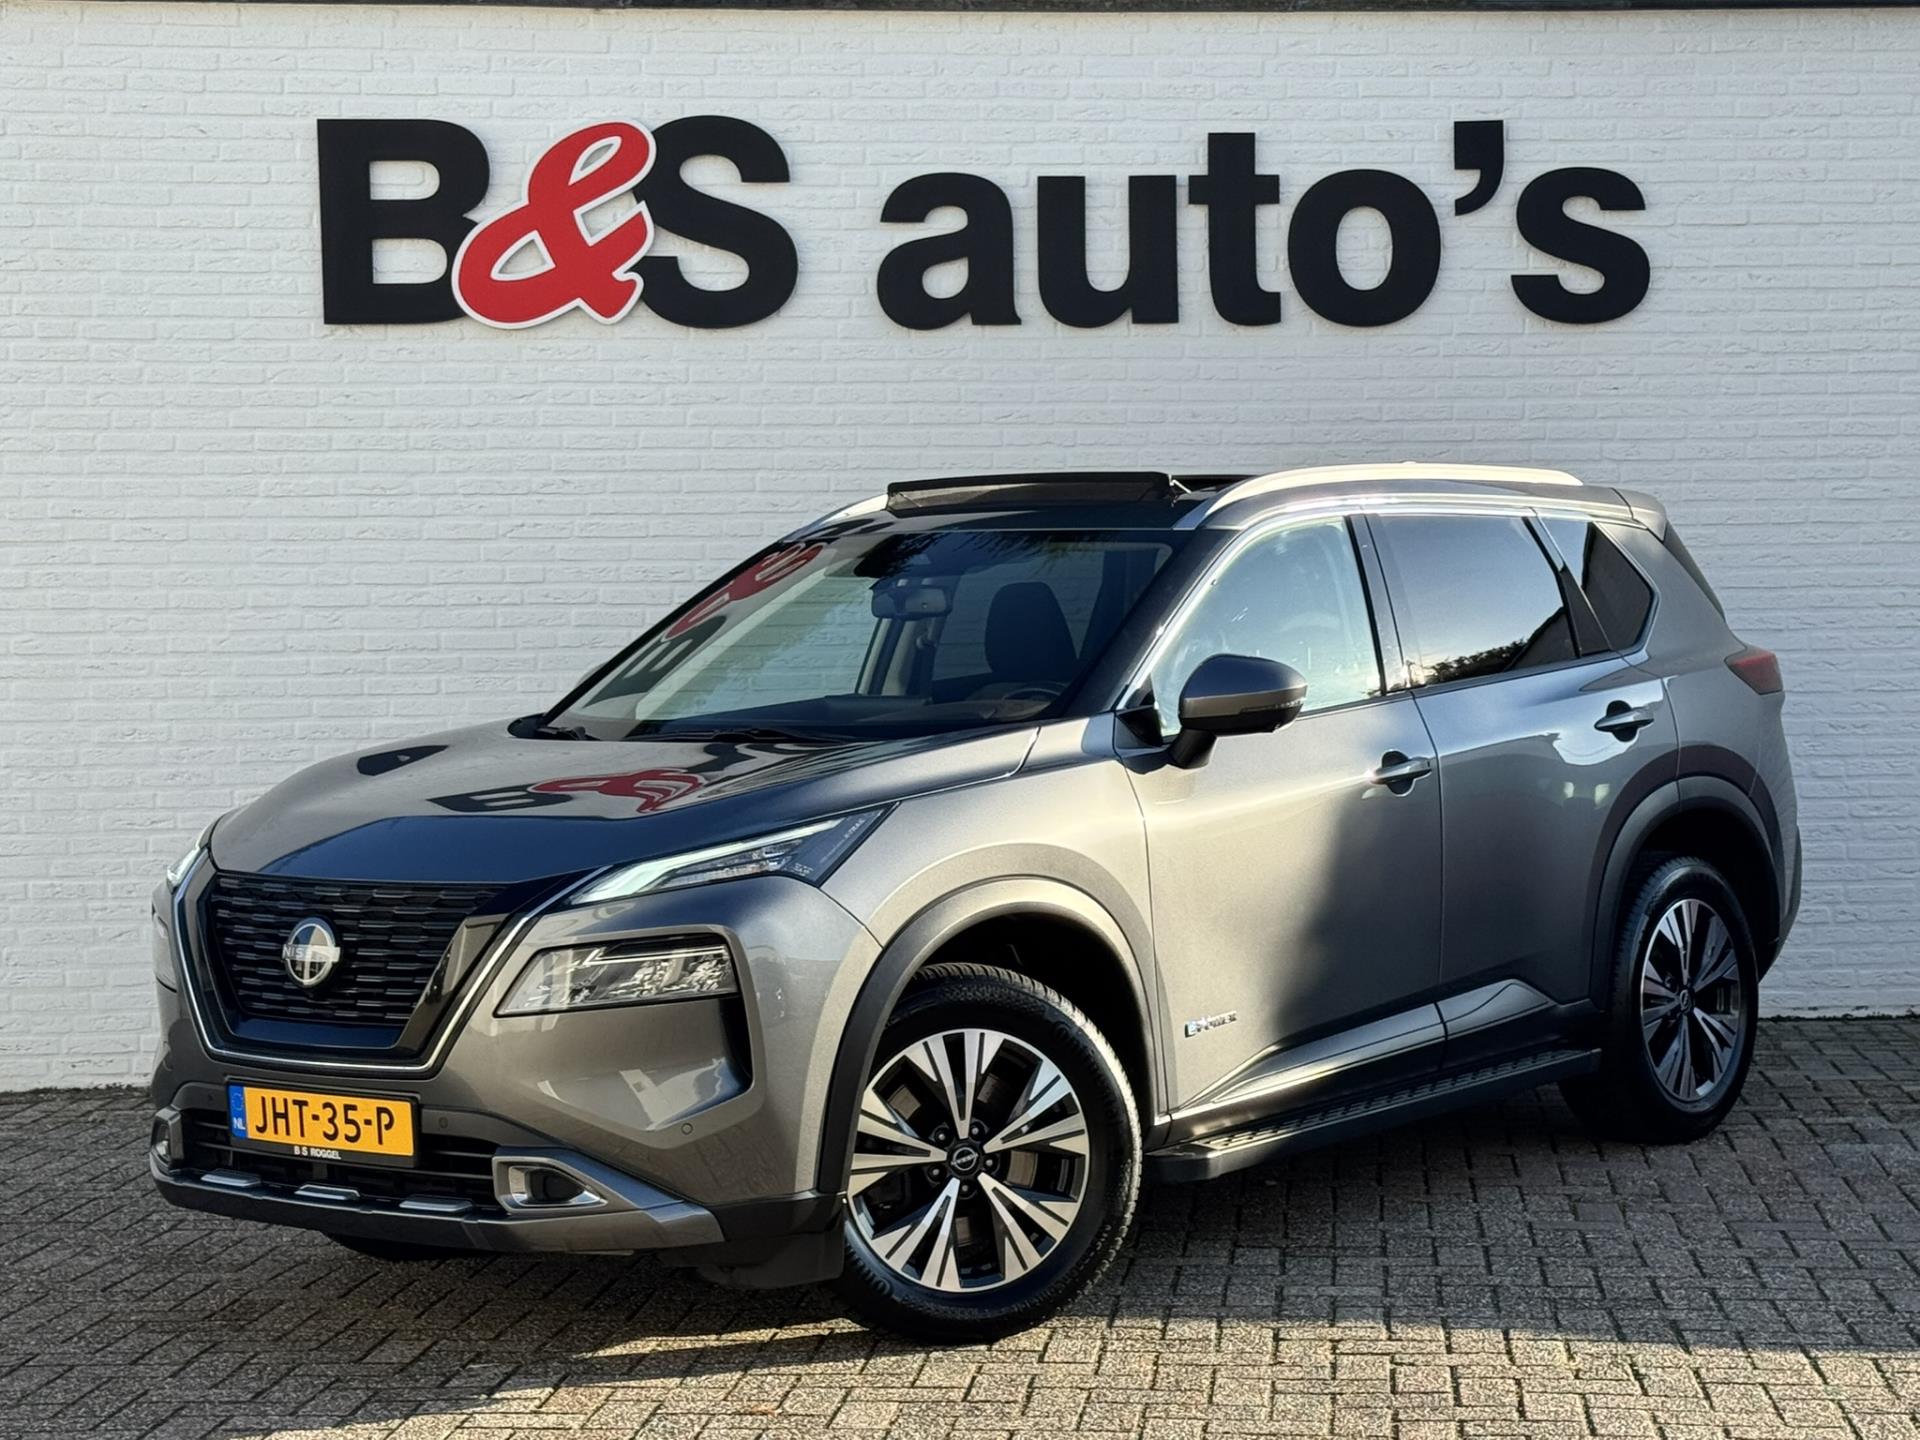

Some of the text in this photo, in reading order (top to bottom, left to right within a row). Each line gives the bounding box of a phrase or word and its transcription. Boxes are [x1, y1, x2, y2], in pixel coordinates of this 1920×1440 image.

[317, 116, 1652, 331] B&S auto's
[282, 943, 341, 963] NIS
[233, 1116, 246, 1130] NL
[256, 1095, 395, 1145] JHT-35-P
[294, 1145, 342, 1160] B S ROGGEL
